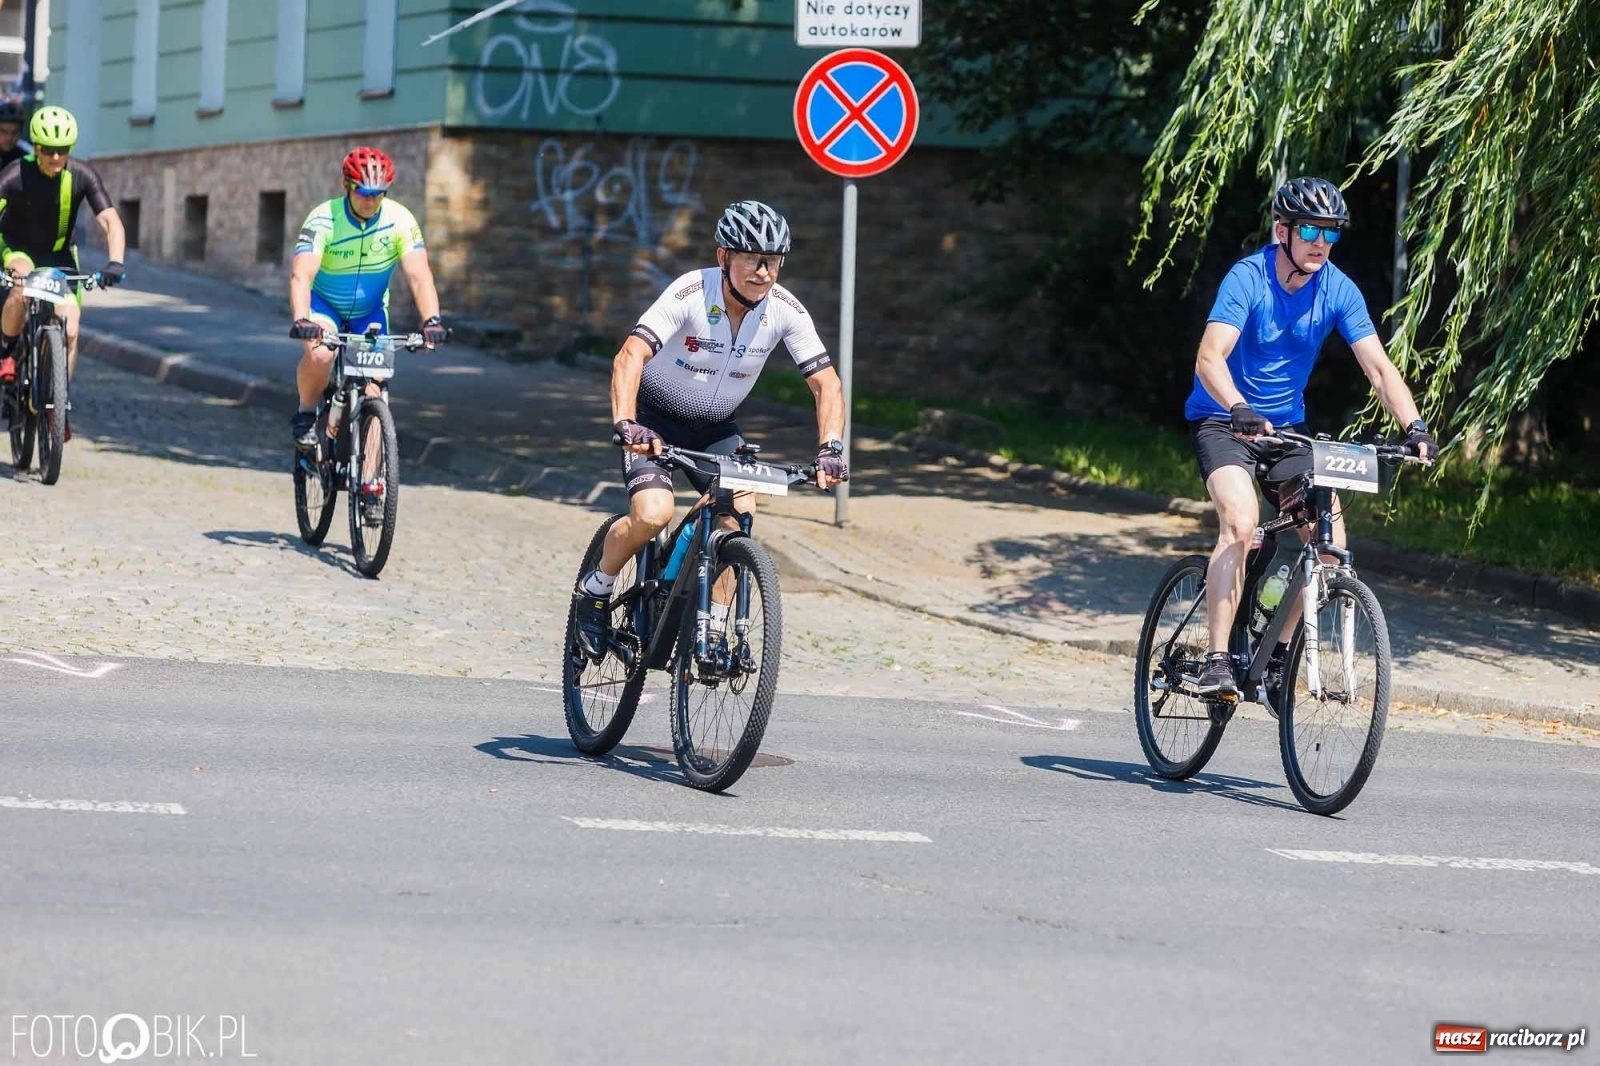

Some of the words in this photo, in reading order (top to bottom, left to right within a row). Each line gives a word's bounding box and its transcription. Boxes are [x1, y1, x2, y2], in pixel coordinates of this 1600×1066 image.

[806, 0, 835, 14] Nie
[844, 0, 910, 19] dotyczy
[356, 351, 385, 365] 1170
[683, 363, 717, 375] Blattin
[733, 461, 772, 477] 1471
[1325, 455, 1368, 475] 2224
